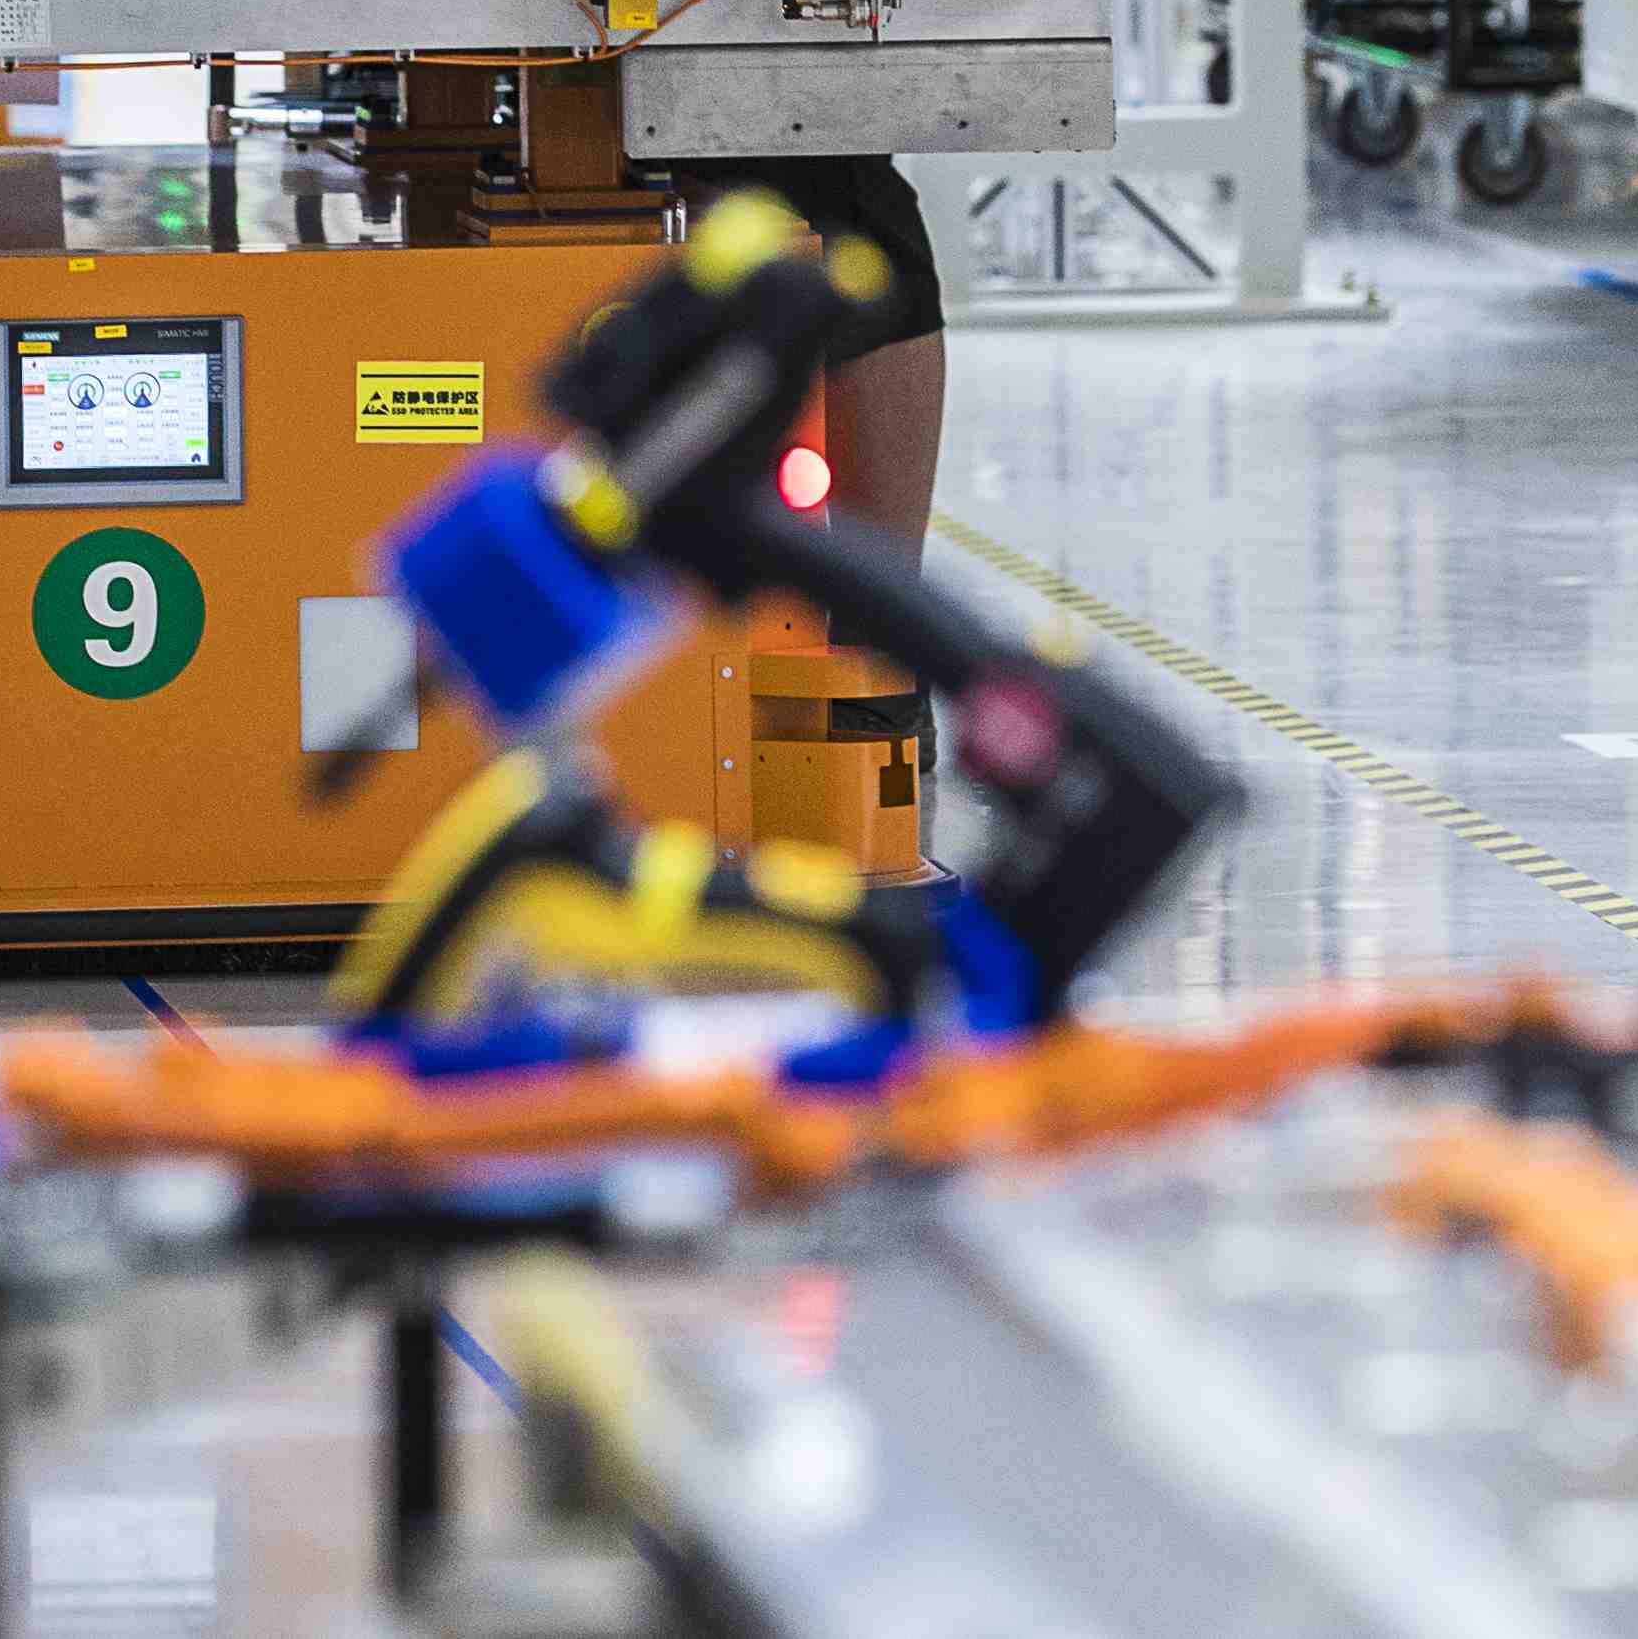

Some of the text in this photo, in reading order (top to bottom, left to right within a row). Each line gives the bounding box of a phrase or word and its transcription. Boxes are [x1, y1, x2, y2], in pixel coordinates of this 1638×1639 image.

[392, 391, 479, 404] 防静电保护区
[82, 561, 158, 667] 9
